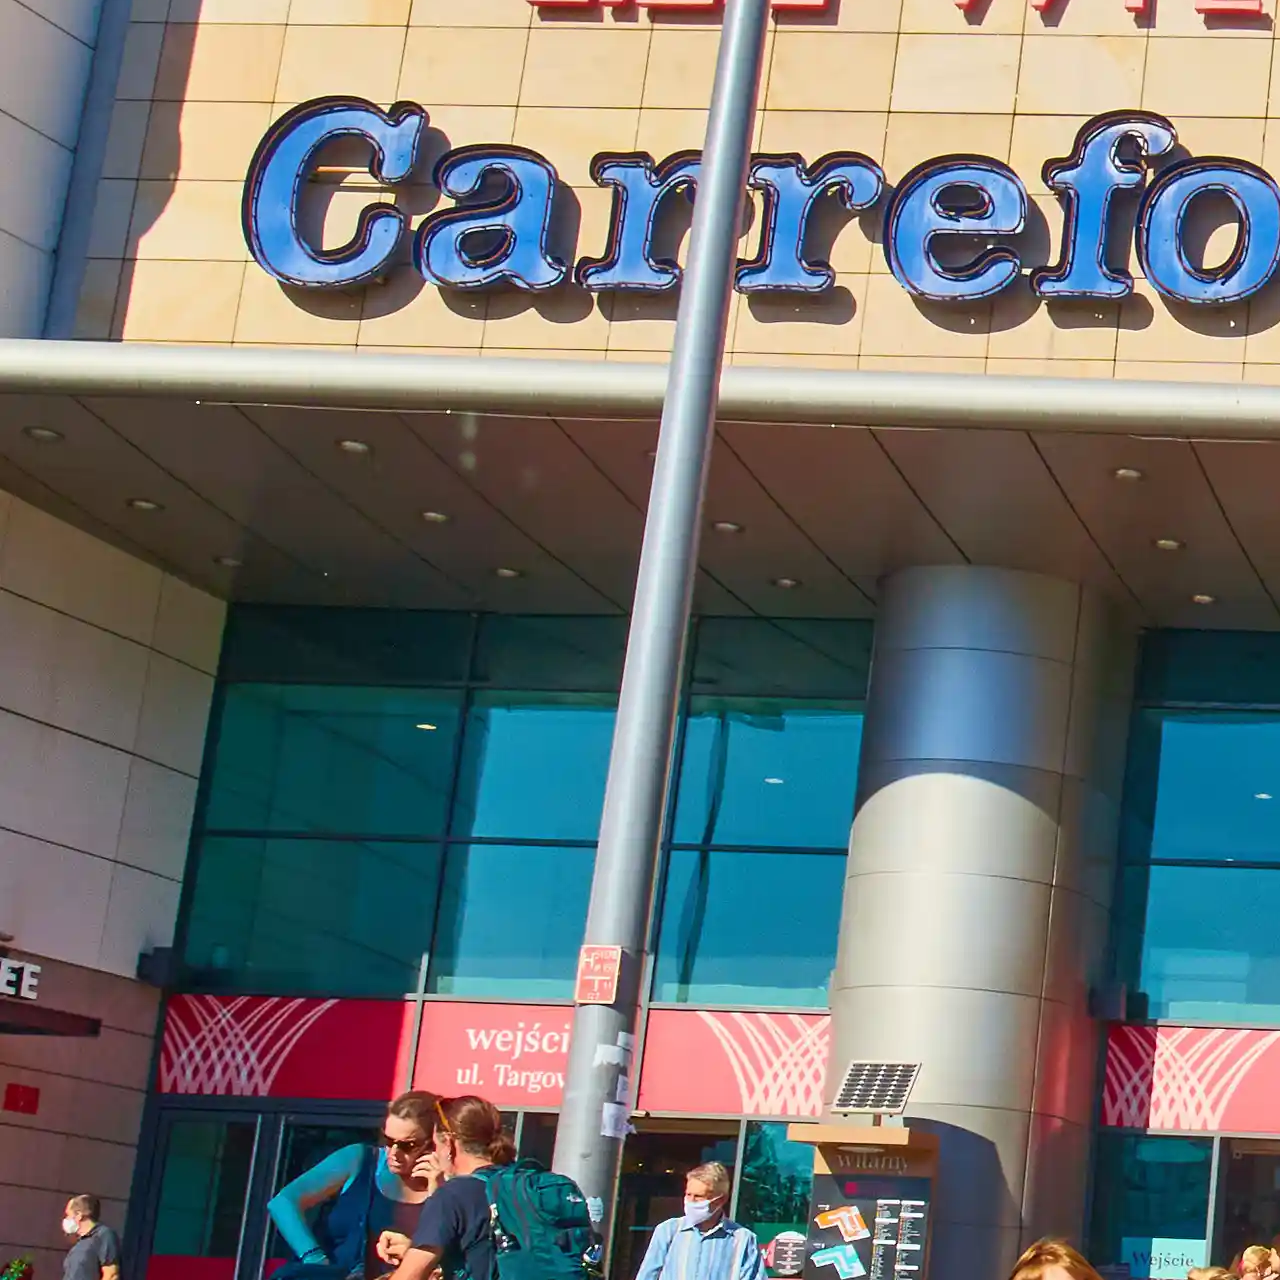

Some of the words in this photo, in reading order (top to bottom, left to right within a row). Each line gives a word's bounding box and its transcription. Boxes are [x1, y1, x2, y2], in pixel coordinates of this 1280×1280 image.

[465, 1022, 571, 1060] wejści
[456, 1063, 484, 1085] ul.
[494, 1064, 566, 1093] Targo
[836, 1153, 909, 1174] witamy
[1132, 1251, 1195, 1270] Wejście
